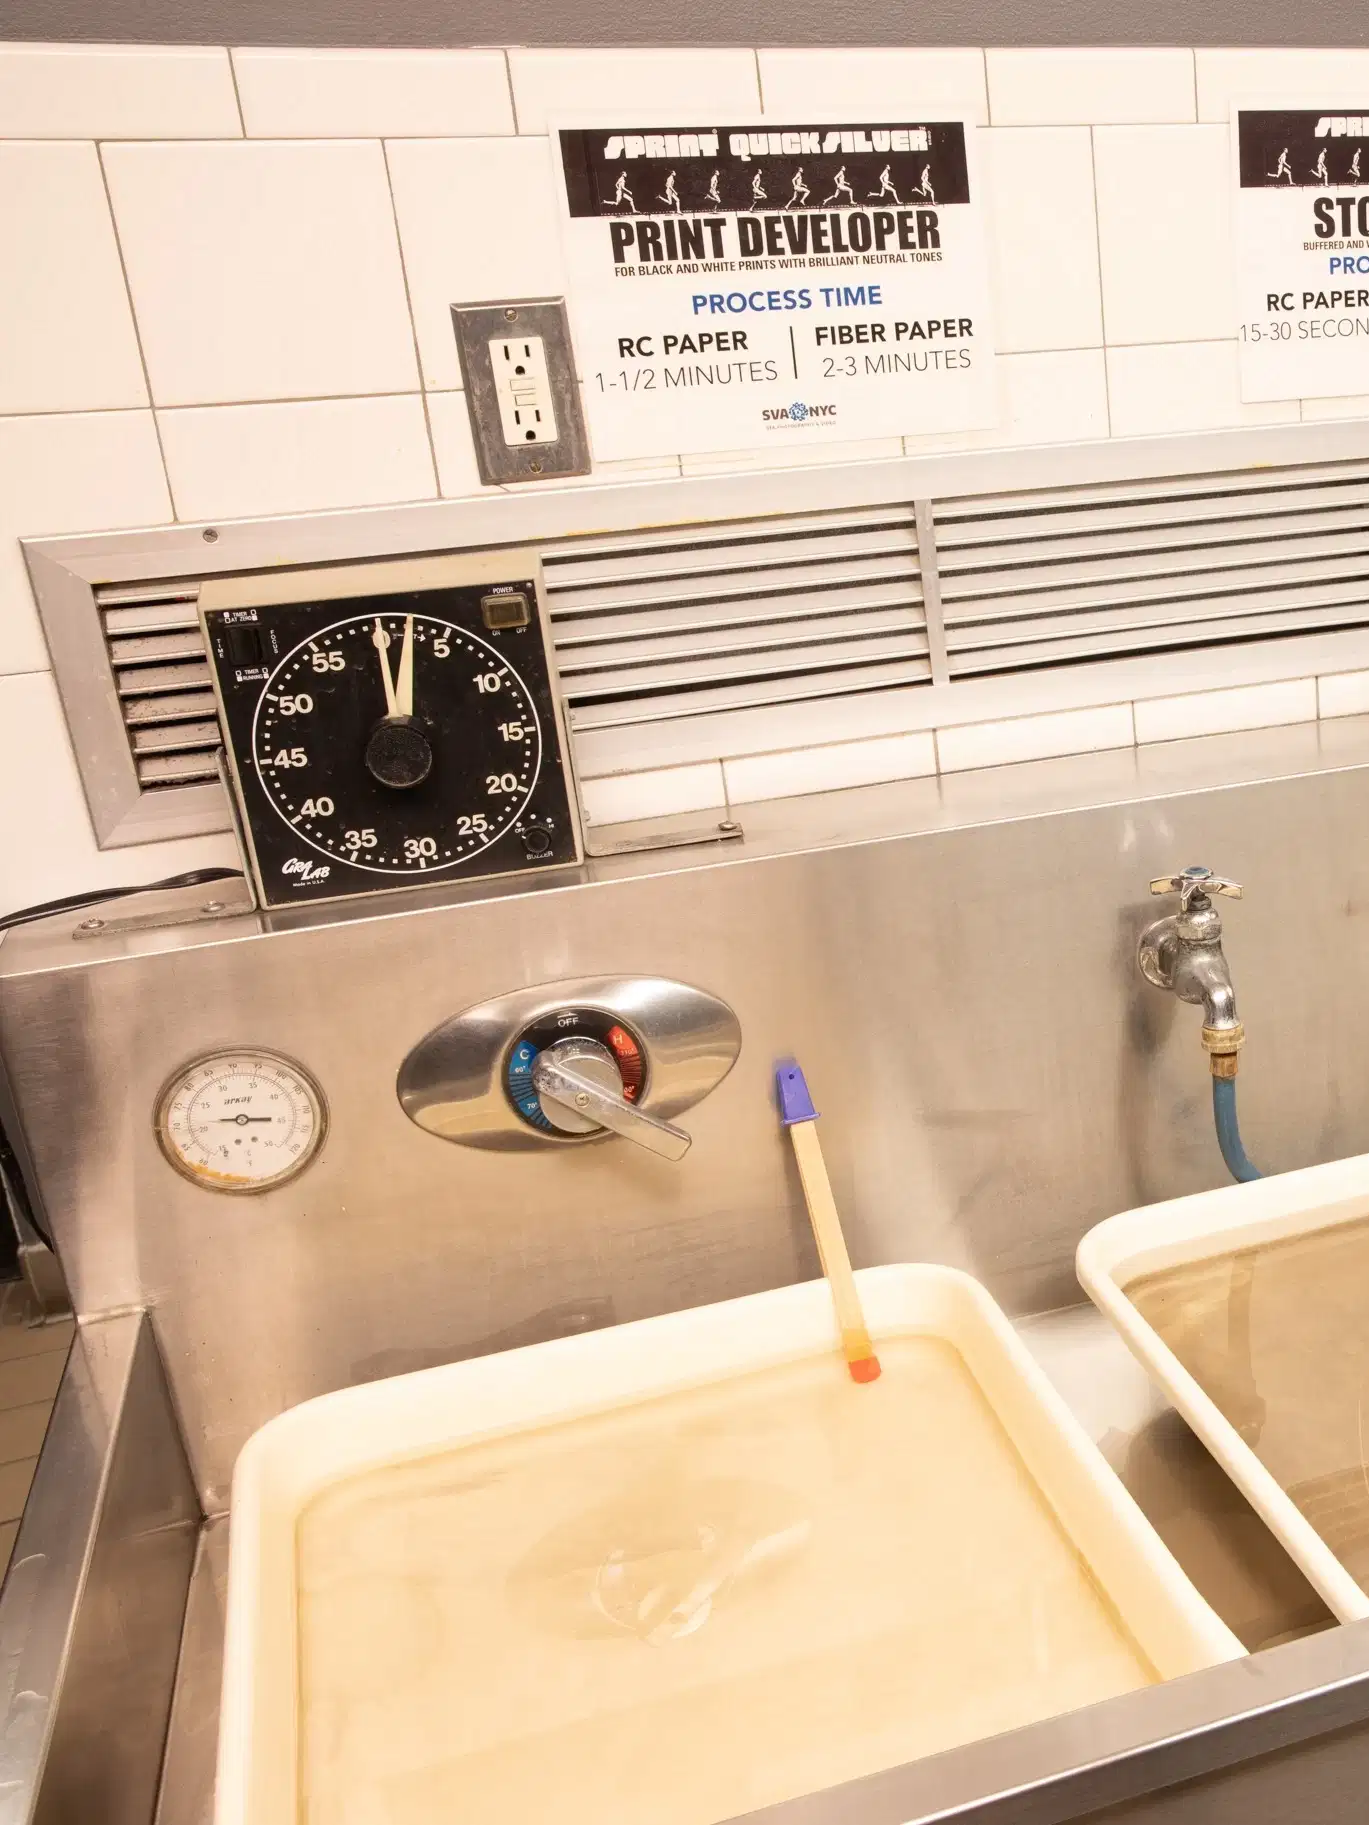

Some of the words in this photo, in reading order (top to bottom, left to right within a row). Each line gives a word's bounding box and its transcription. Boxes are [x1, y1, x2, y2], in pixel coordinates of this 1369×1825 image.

[604, 134, 719, 159] SPRINT
[609, 218, 727, 263] PRINT
[736, 210, 941, 257] DEVELOPER
[1303, 241, 1345, 251] BUFFERED
[1346, 240, 1365, 249] AND
[614, 266, 636, 277] FOR
[638, 264, 674, 276] BLACK
[676, 263, 699, 274] AND
[701, 261, 736, 273] WHITE
[738, 259, 776, 271] PRINTS
[778, 258, 806, 269] WITH
[808, 255, 860, 267] BRILLIANT
[862, 254, 908, 265] NEUTRAL
[911, 252, 943, 262] TONES
[692, 288, 813, 315] PROCESS
[819, 285, 883, 307] TIME
[1267, 292, 1295, 312] RC
[1302, 289, 1369, 310] PAPER
[815, 323, 887, 346] FIBER
[894, 318, 974, 341] PAPER
[1240, 321, 1292, 342] 15-30
[618, 336, 655, 358] RC
[663, 330, 749, 355] PAPER
[822, 356, 857, 378] 2-3
[865, 348, 972, 375] MINUTES
[595, 369, 657, 393] 1-1/2
[664, 360, 779, 388] MINUTES
[762, 409, 789, 420] SVA
[809, 405, 837, 417] NYC
[216, 638, 224, 659] TIME
[270, 629, 279, 654] FOCUS
[433, 638, 451, 658] 5
[312, 651, 346, 672] 55
[473, 673, 501, 694] 10
[279, 693, 314, 715] 50
[498, 722, 525, 742] 15
[273, 747, 308, 769] 45
[485, 773, 518, 795] 20
[301, 796, 335, 818] 40
[456, 813, 488, 835] 25
[344, 828, 378, 850] 35
[403, 836, 437, 858] 30
[557, 1016, 579, 1028] OFF
[612, 1034, 623, 1045] H
[519, 1049, 530, 1060] C
